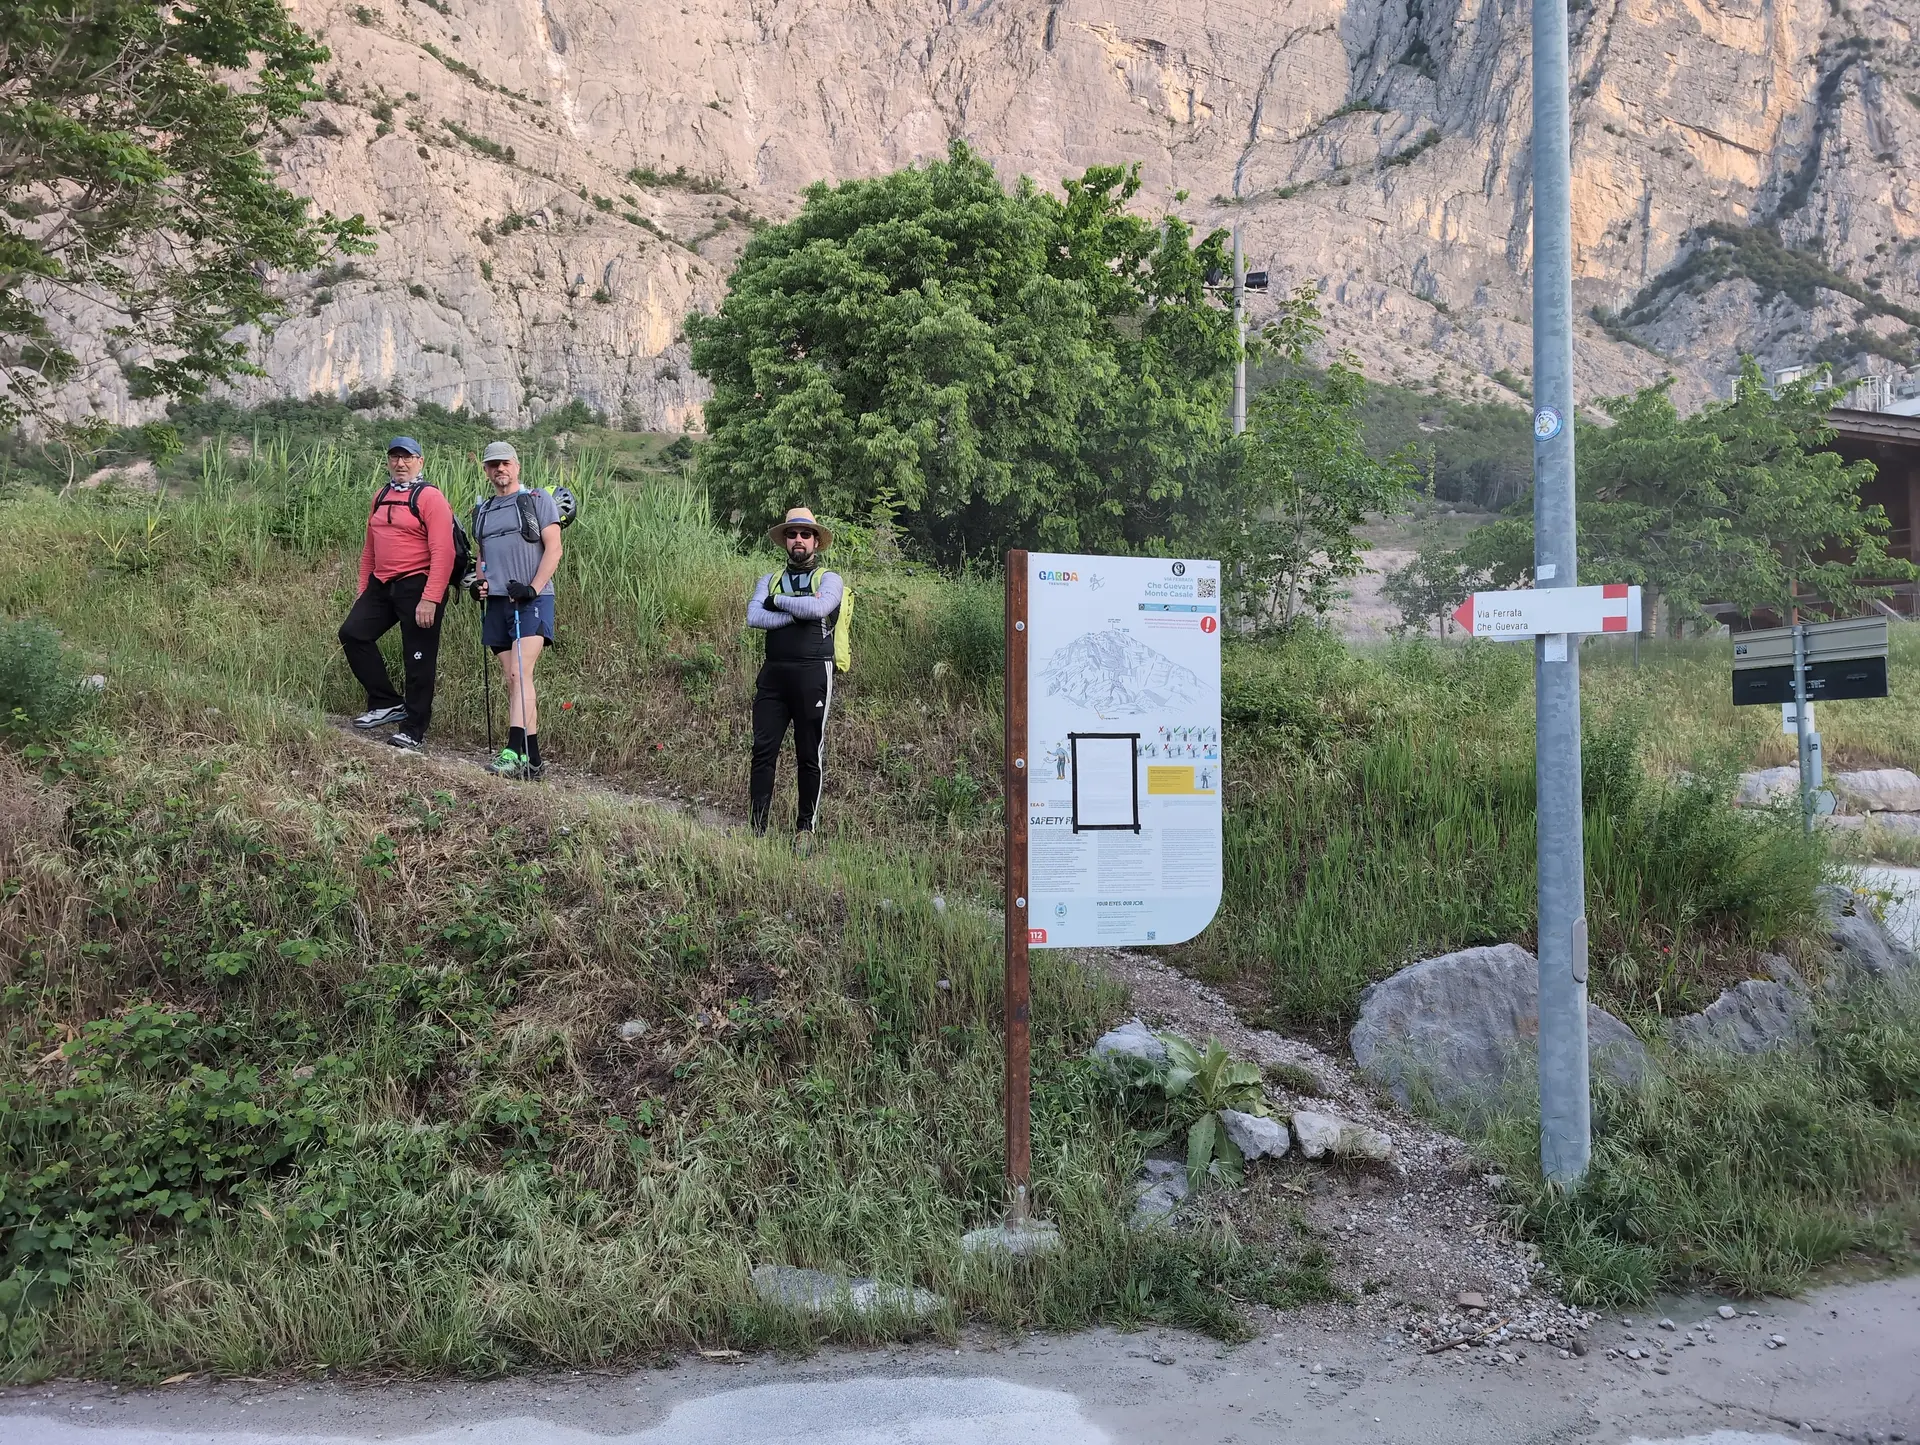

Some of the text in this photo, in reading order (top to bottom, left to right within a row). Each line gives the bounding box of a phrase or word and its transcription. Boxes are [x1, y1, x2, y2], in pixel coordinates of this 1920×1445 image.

[1038, 570, 1078, 581] GARDA
[1163, 582, 1193, 590] Guevara
[1477, 608, 1522, 618] Via Ferrata
[1477, 622, 1529, 631] Che Guevara
[1030, 816, 1064, 825] SAFETY
[1030, 931, 1043, 939] 112
